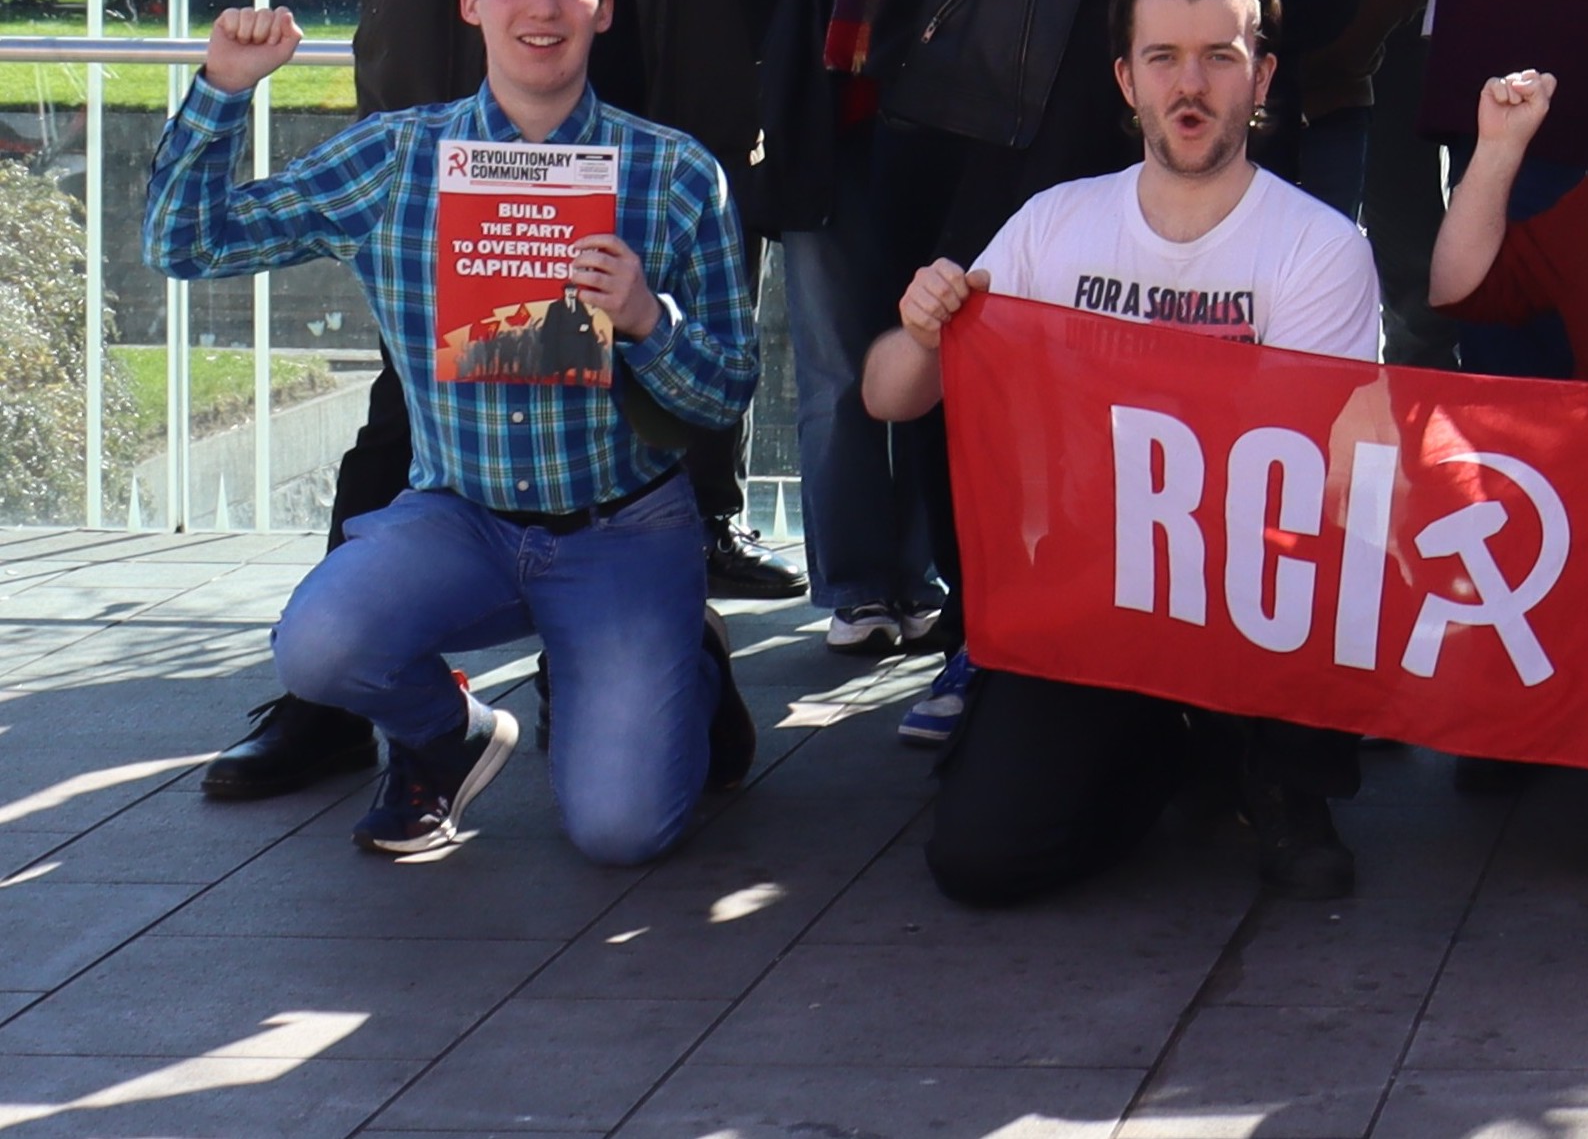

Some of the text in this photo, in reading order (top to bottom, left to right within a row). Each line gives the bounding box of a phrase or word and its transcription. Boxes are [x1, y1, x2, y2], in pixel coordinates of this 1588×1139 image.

[471, 150, 572, 167] REVOLUTIONARY
[471, 167, 548, 181] COMMUNIST
[499, 203, 556, 219] BUILD
[481, 223, 573, 239] THE PARTY
[453, 241, 581, 258] TO OVERTHRO
[456, 258, 573, 279] CAPITALIS
[1074, 275, 1122, 313] FOR
[1121, 283, 1140, 317] A
[1110, 404, 1399, 671] RCI
